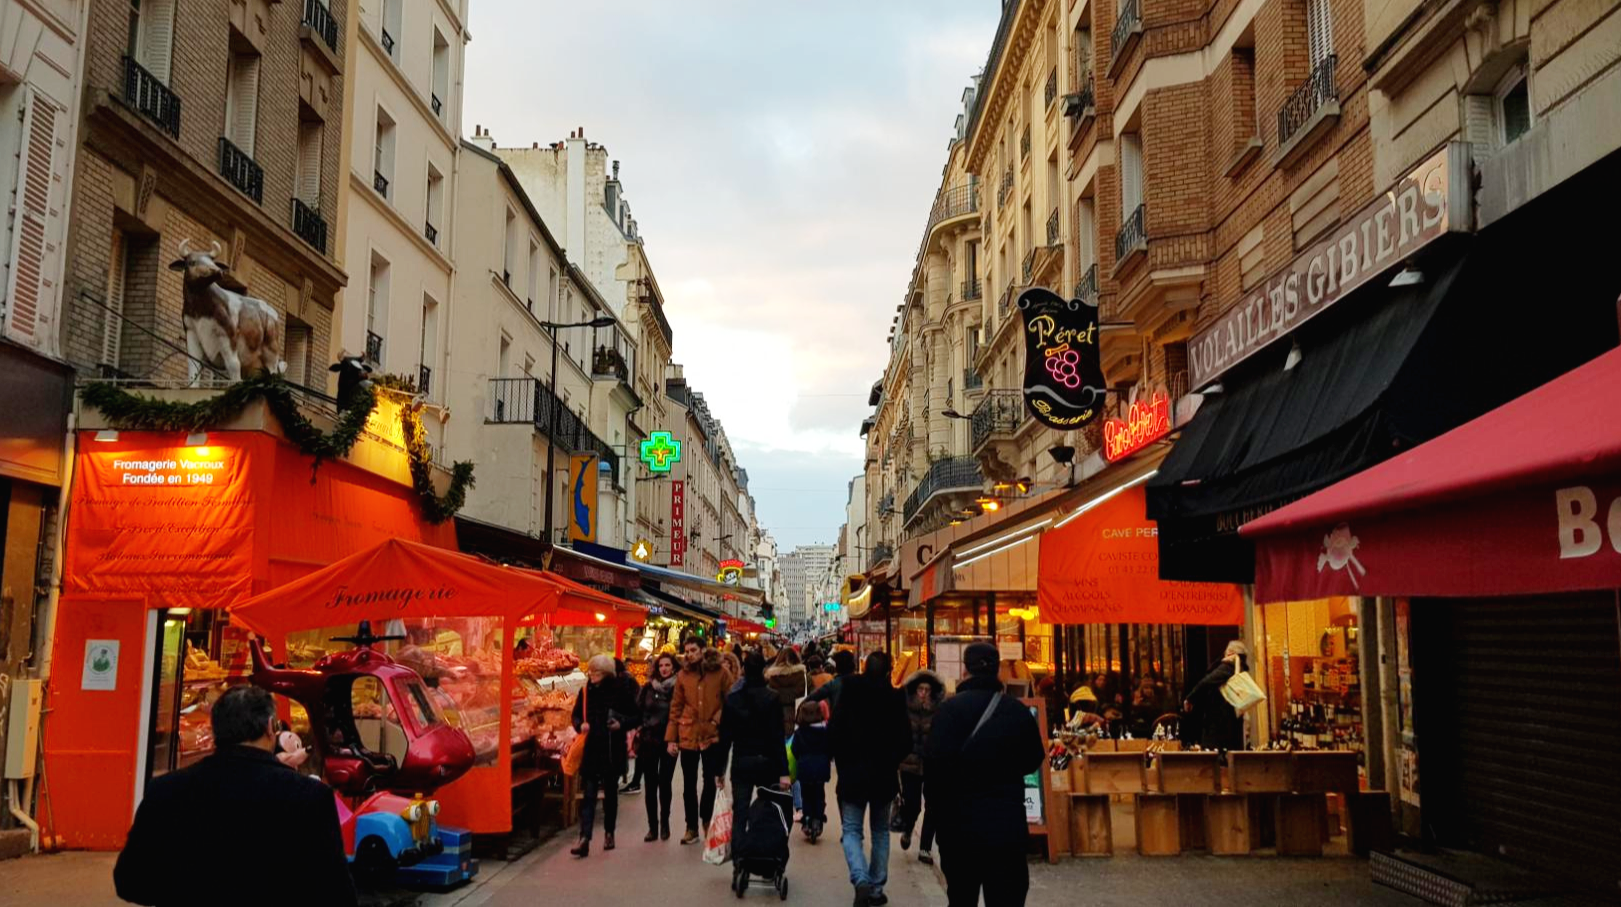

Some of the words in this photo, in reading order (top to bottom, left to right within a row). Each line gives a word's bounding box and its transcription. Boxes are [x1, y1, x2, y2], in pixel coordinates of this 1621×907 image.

[1190, 270, 1299, 380] VOLAILLES
[1306, 163, 1446, 305] GIBIERS
[1028, 314, 1097, 349] Péret
[1031, 399, 1094, 425] Brasserie
[113, 459, 177, 472] Fromagerie
[180, 459, 224, 470] Vacroux
[122, 473, 165, 484] Fondée
[168, 475, 182, 484] en
[186, 473, 213, 484] 1949
[142, 496, 198, 507] Tradition
[672, 483, 683, 563] PRIMEUR
[1101, 527, 1132, 539] CAVE
[1098, 552, 1139, 561] CAVISTE
[1108, 565, 1119, 574] 01
[1074, 578, 1099, 587] VINS
[325, 583, 457, 610] Fromagerie
[1062, 591, 1111, 600] ALCOOLS
[1051, 604, 1125, 614] CHAMPAGNES
[1167, 604, 1223, 614] LIVRAISON
